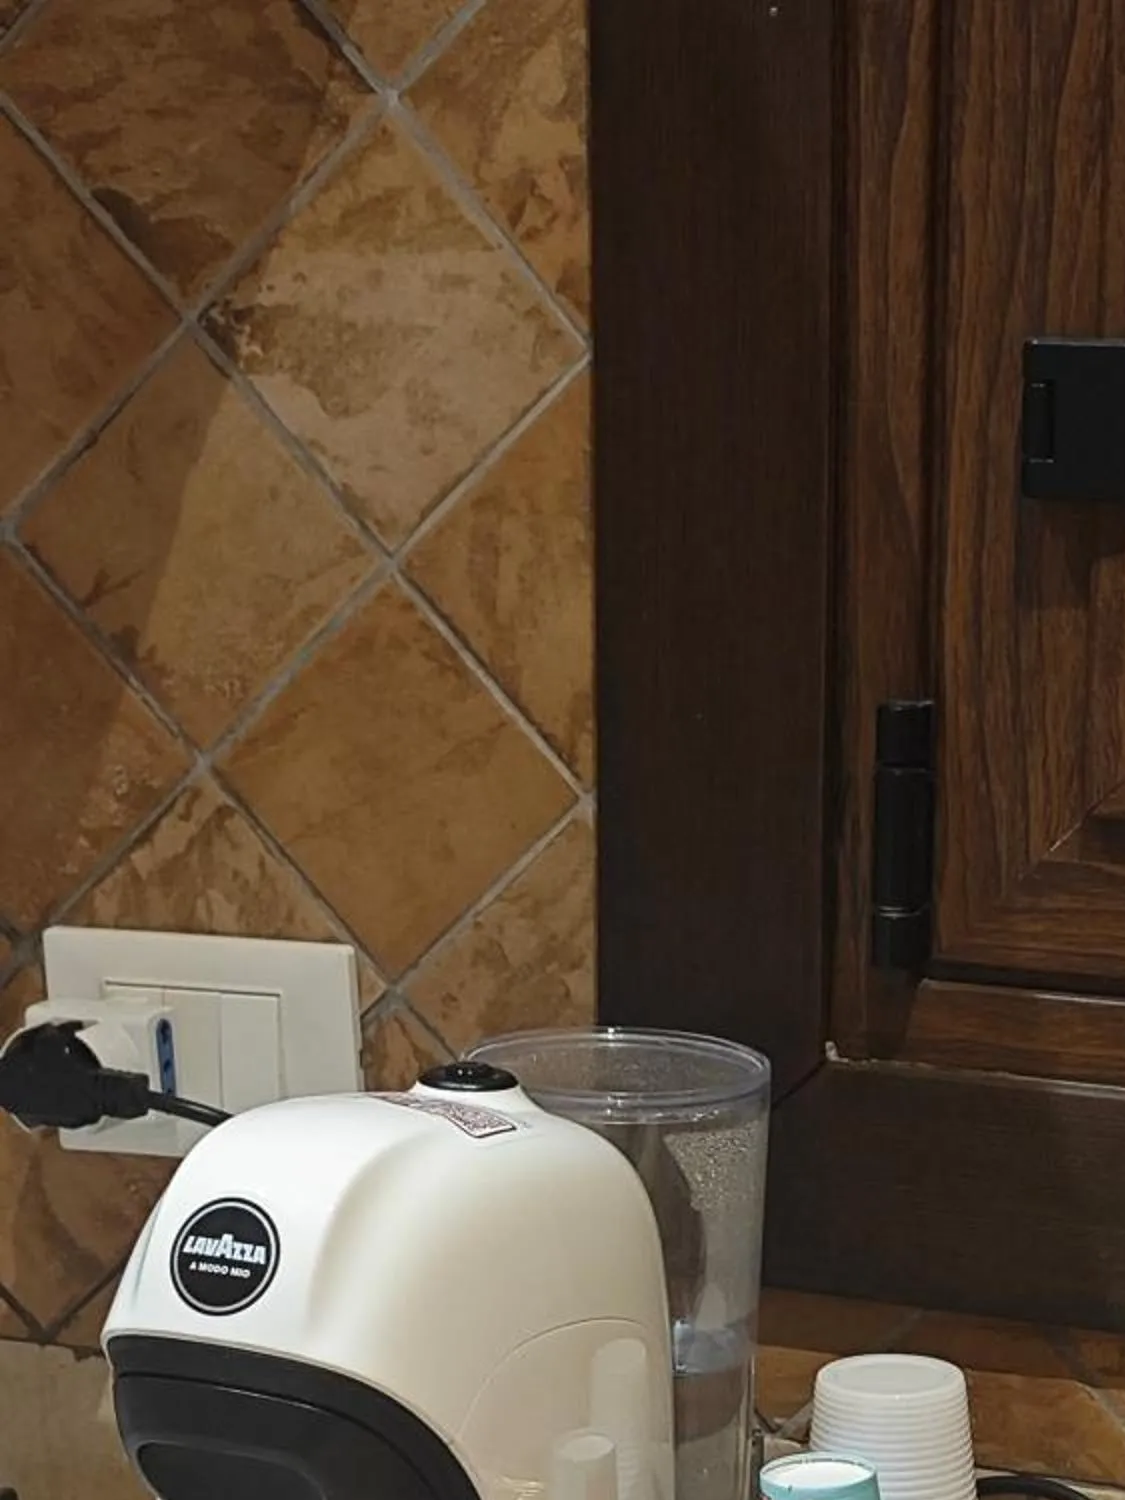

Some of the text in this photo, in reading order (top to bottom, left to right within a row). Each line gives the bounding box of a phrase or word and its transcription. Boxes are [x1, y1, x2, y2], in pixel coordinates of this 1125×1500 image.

[183, 1233, 266, 1265] LAVAZZA
[189, 1261, 251, 1279] A MODO MIO
